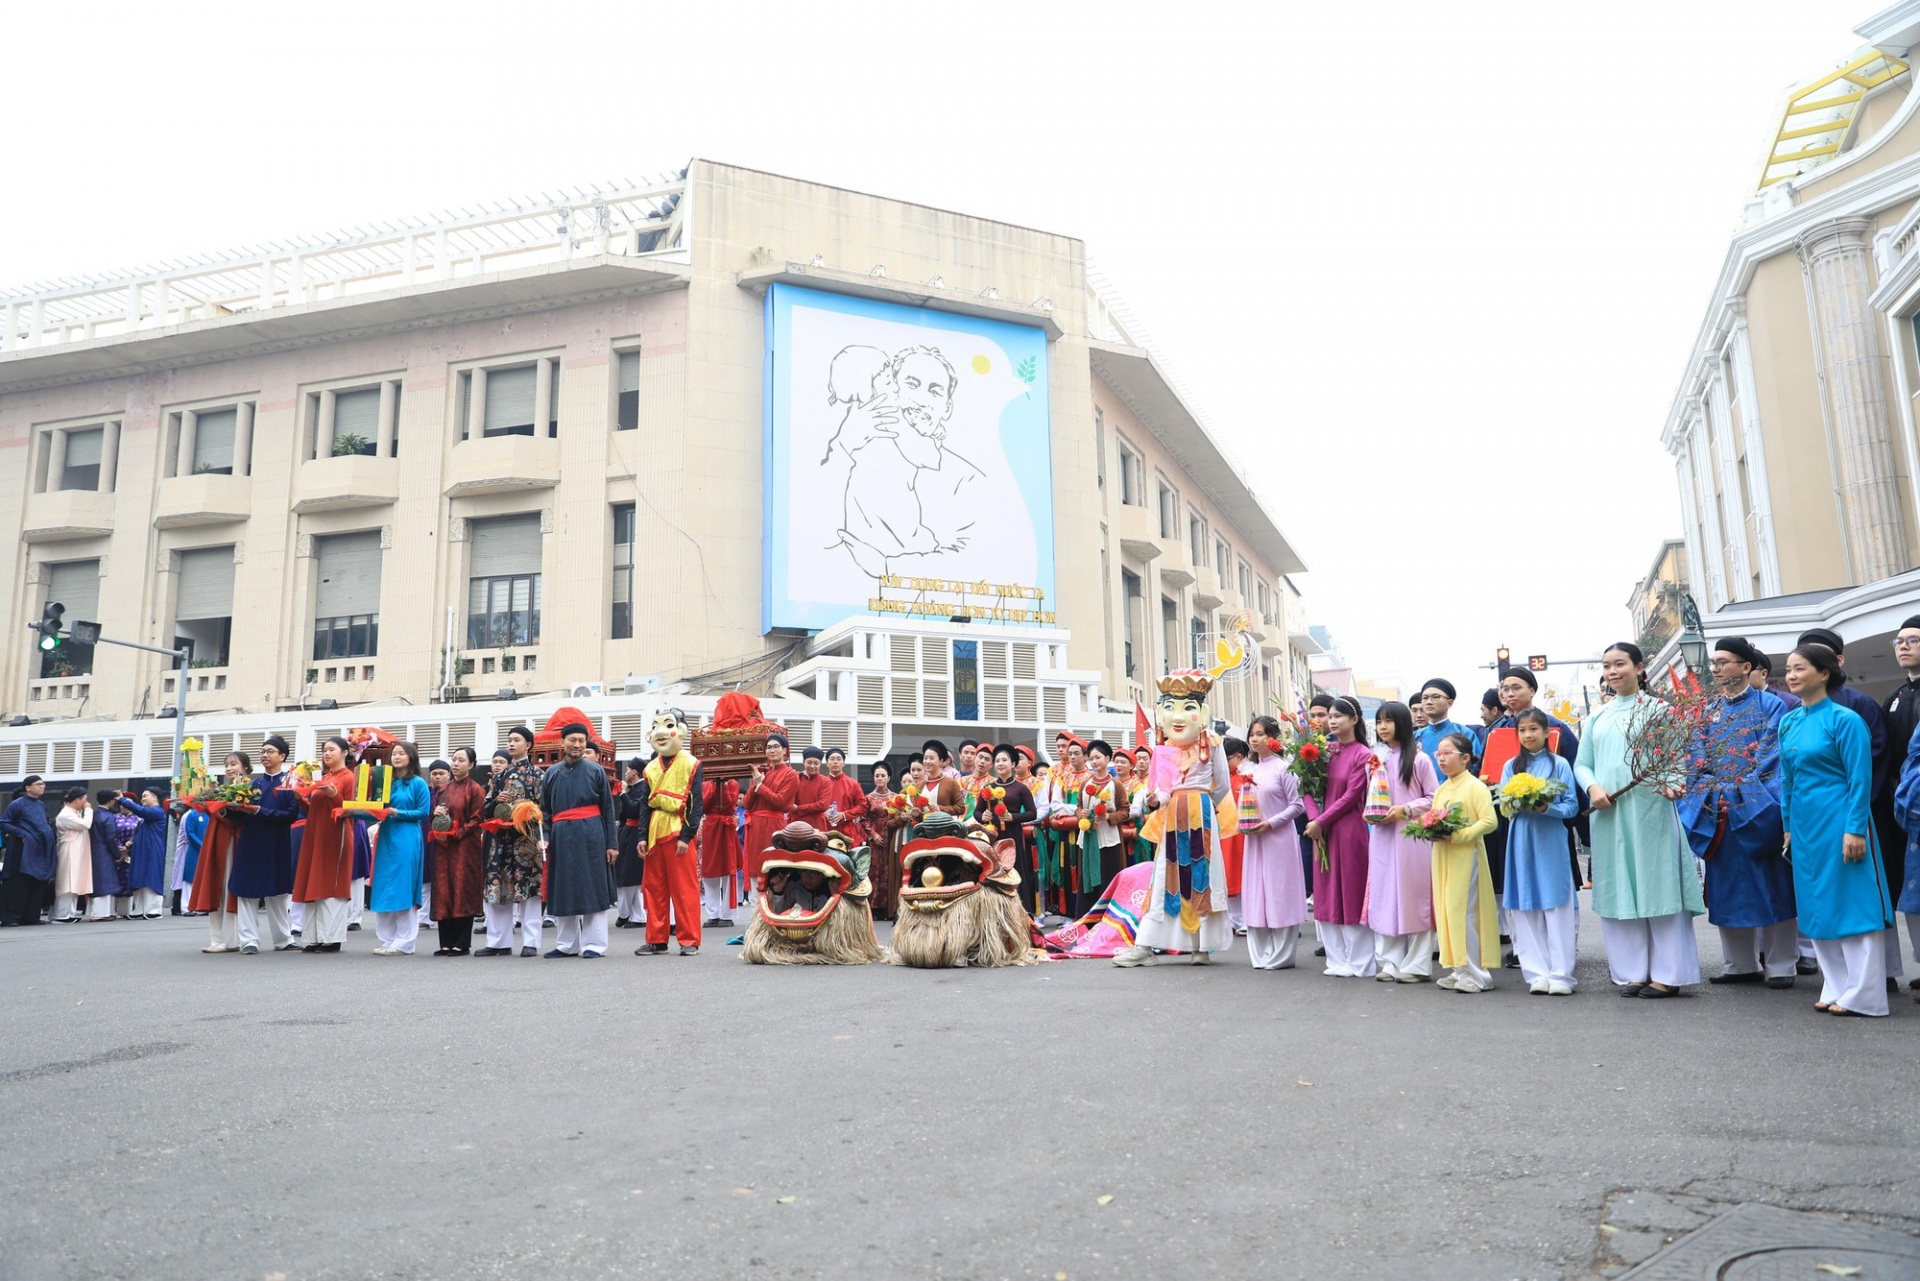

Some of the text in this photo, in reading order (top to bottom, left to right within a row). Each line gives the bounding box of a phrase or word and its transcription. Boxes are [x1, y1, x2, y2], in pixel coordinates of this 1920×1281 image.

[1033, 587, 1045, 600] TA
[991, 607, 1005, 620] TO
[1532, 658, 1545, 669] 32
